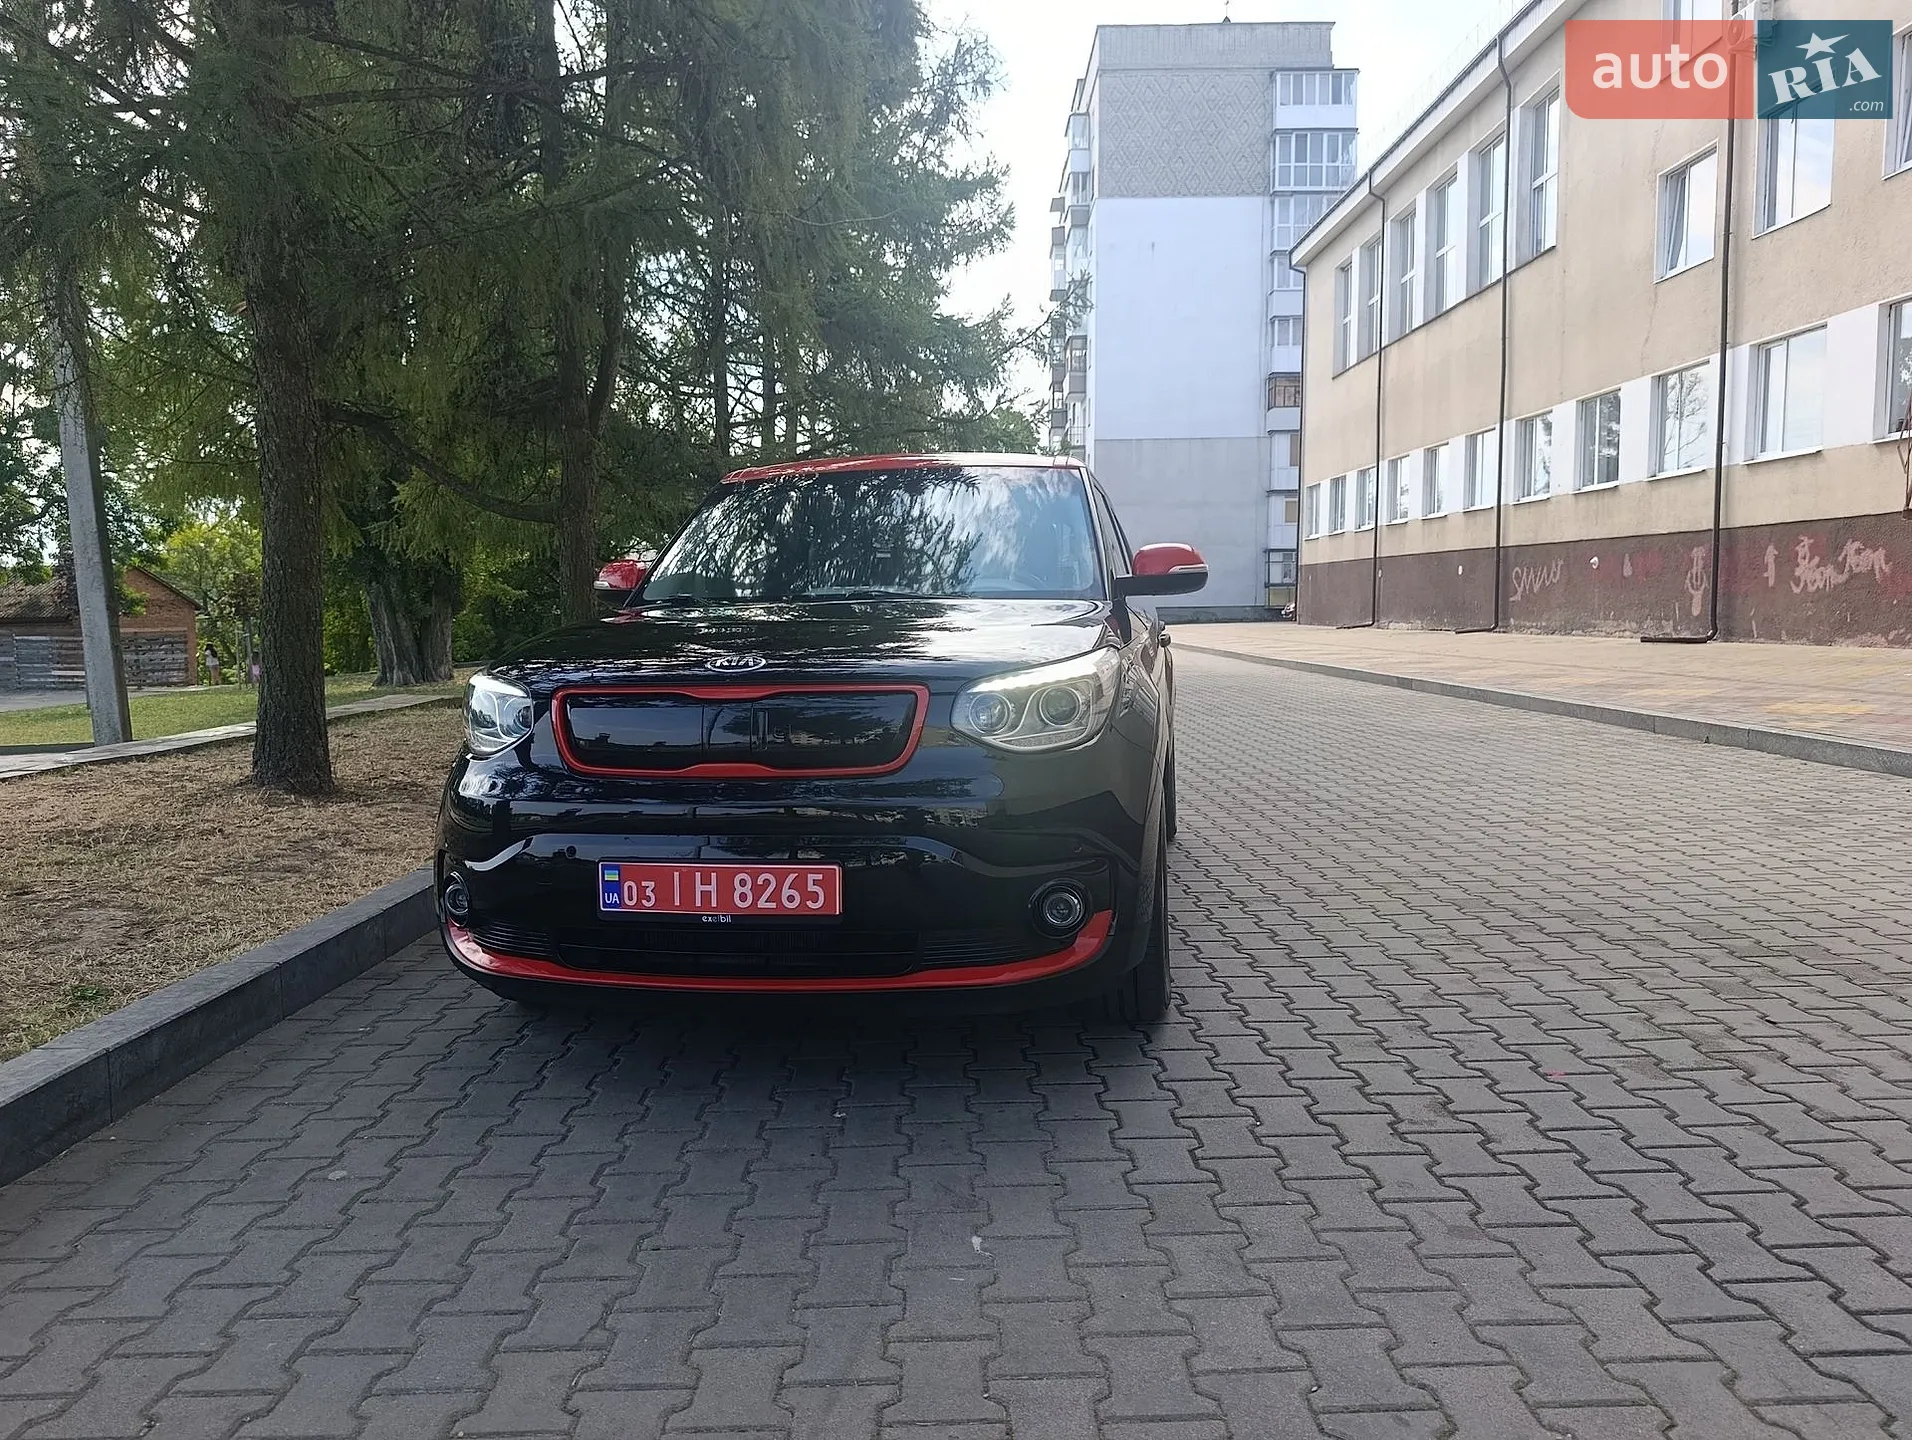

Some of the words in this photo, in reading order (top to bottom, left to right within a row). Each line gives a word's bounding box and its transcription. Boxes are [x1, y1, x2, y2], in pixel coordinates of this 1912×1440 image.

[714, 656, 754, 667] KIA
[623, 880, 656, 908] 03
[733, 872, 825, 910] 8265
[604, 892, 620, 905] UA
